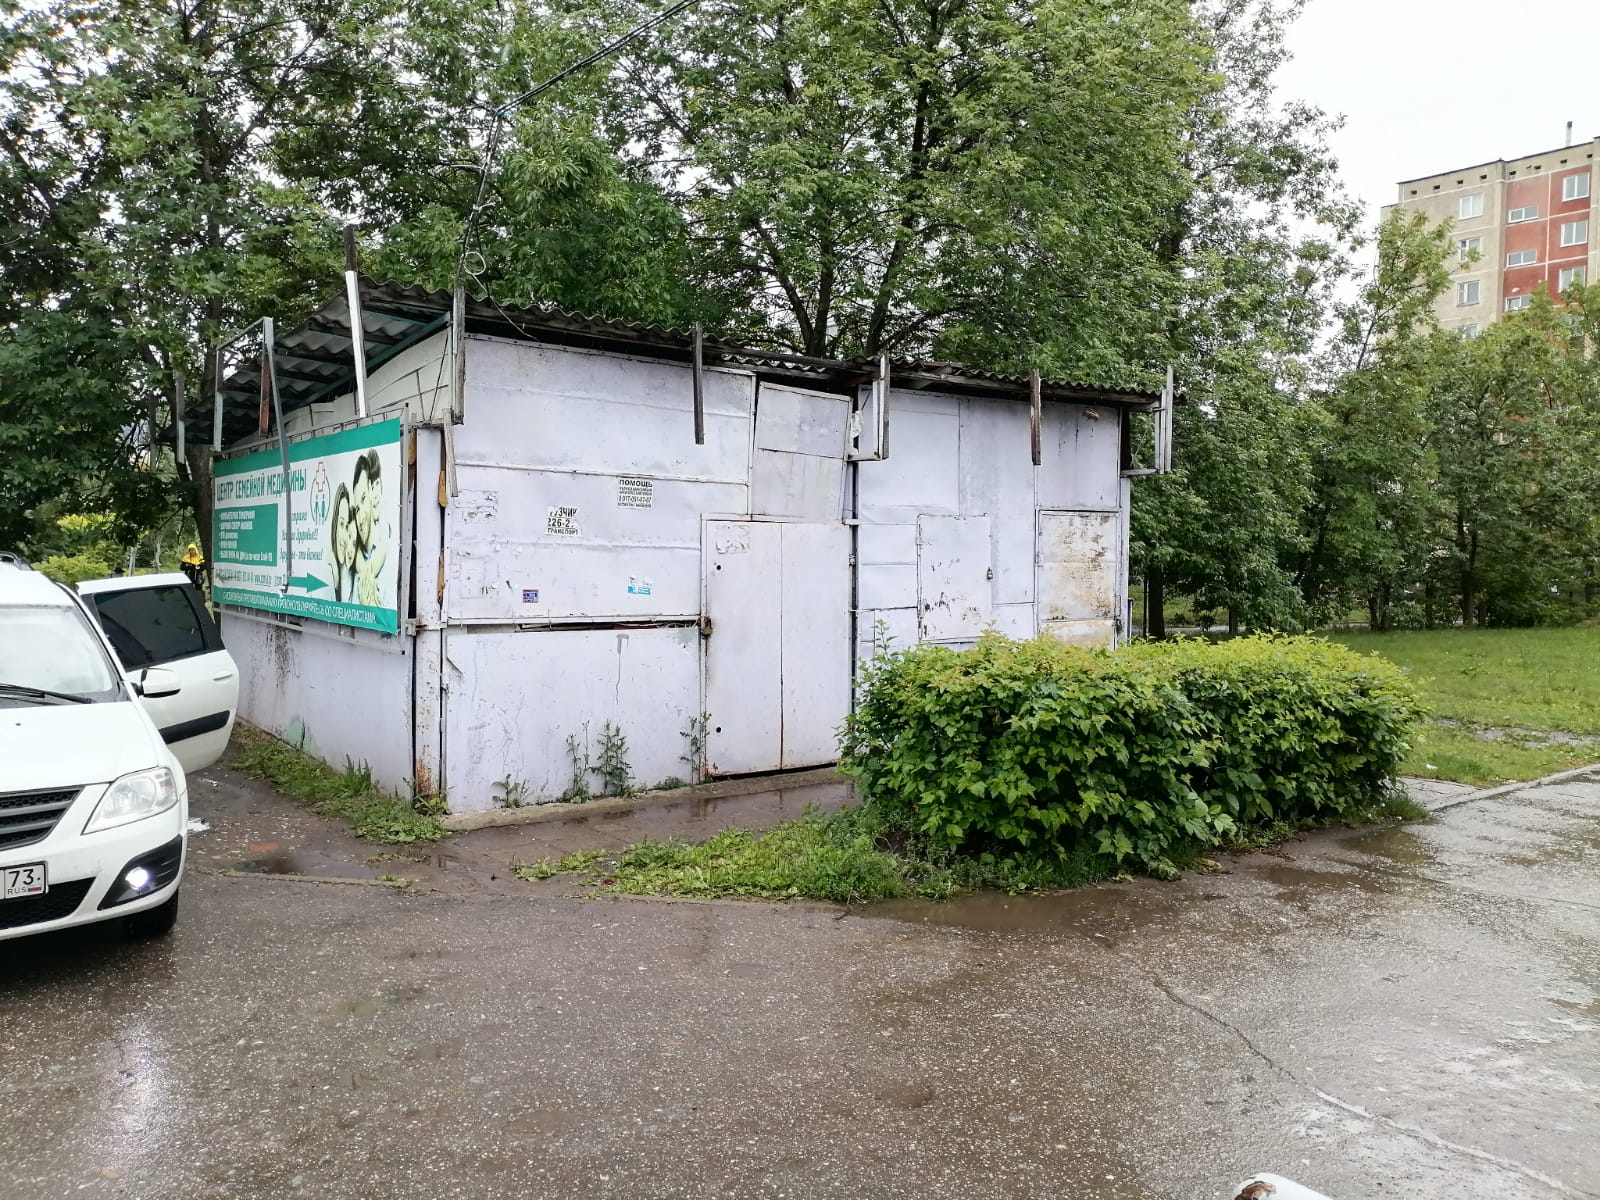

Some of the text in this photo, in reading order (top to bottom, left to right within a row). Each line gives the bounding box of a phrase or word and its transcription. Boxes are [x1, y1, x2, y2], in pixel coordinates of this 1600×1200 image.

[217, 467, 307, 504] ЦЕНТР СЕМЕЙНОЙ МЕДИИНЫ
[619, 479, 653, 488] ПОМОЩЬ
[8, 868, 34, 888] 73
[7, 887, 26, 895] RUS
